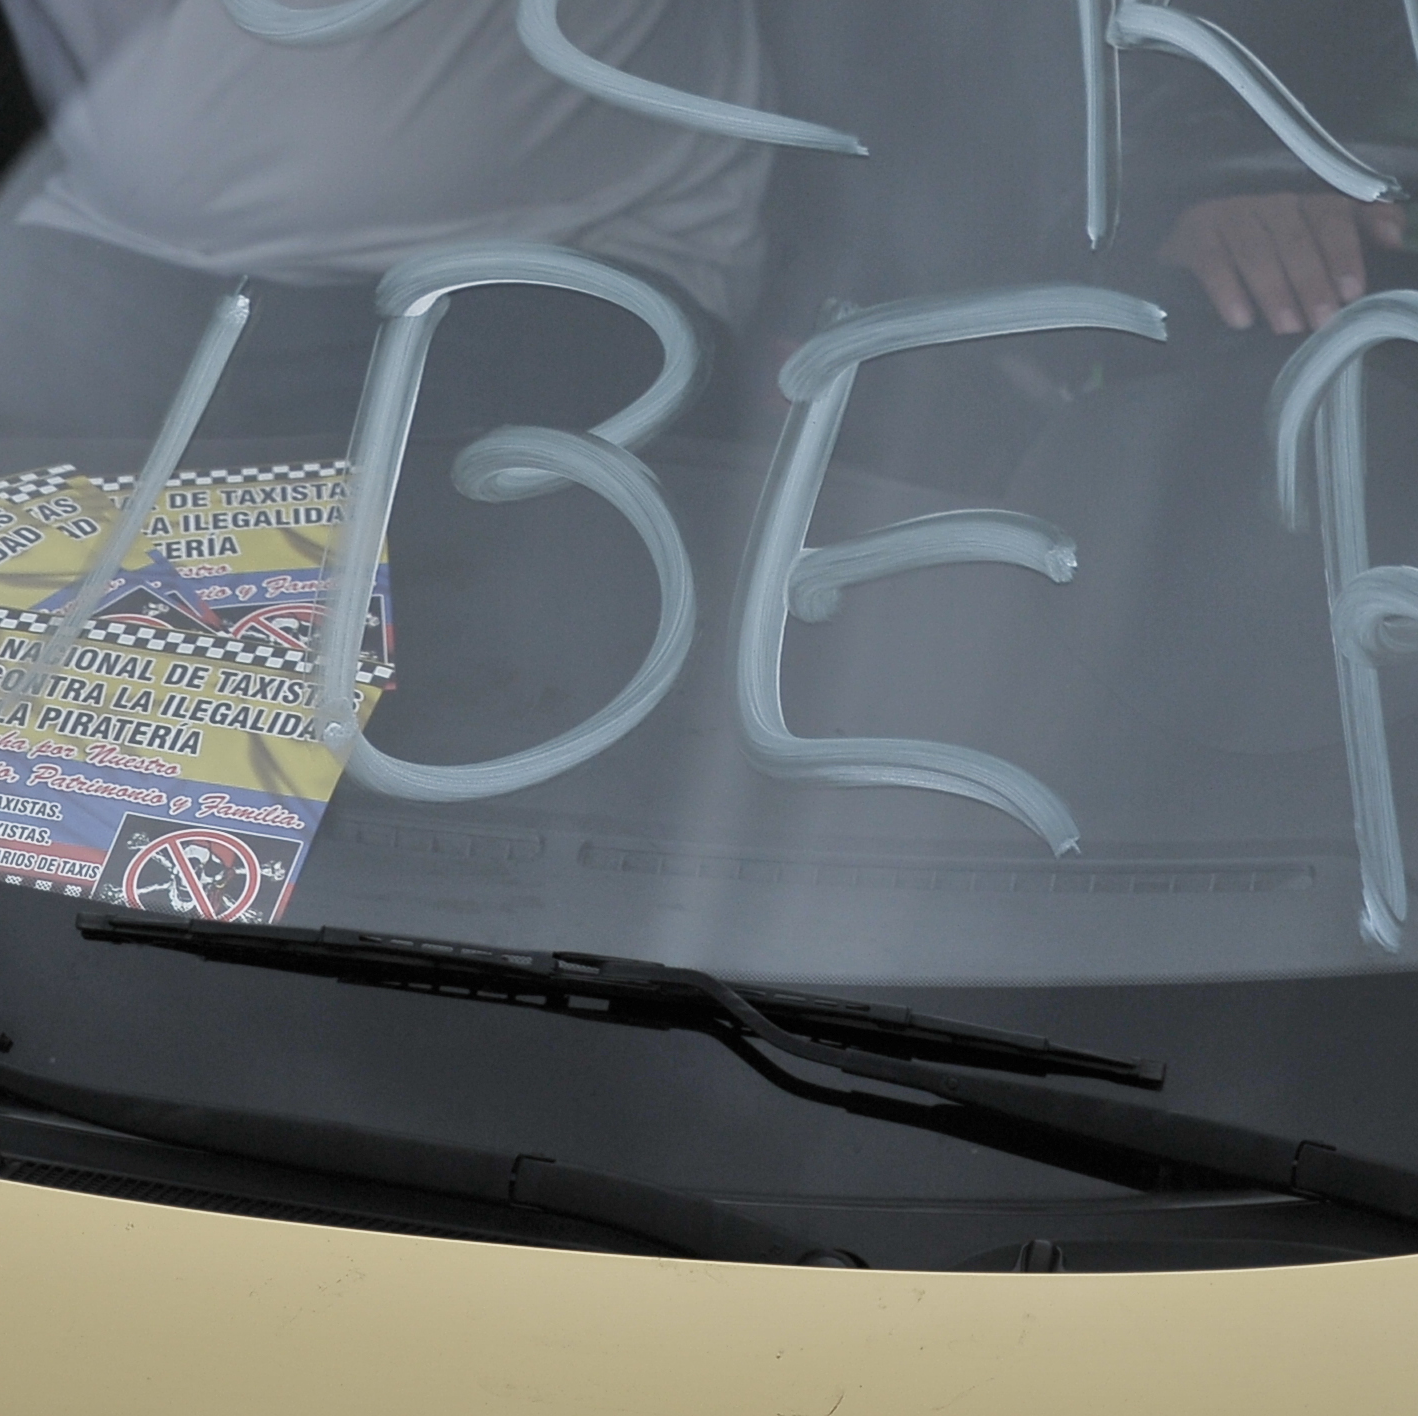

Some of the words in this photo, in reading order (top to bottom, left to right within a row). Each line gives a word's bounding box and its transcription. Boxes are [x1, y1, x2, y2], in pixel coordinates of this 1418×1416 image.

[166, 489, 210, 511] DE
[218, 481, 351, 507] TAXISTA
[181, 504, 346, 533] ILEGALIDA
[163, 661, 210, 691] DE
[216, 670, 365, 713] TAXIST
[36, 705, 204, 757] PIRATERÍA
[112, 686, 152, 714] LA
[159, 694, 323, 744] ILEGALIDA
[27, 738, 79, 762] por
[84, 742, 182, 778] Nuestro
[27, 763, 168, 806] Patrimonio
[169, 795, 192, 816] y
[195, 791, 306, 829] Familia.
[35, 855, 59, 875] DE
[58, 858, 103, 882] TAXIS
